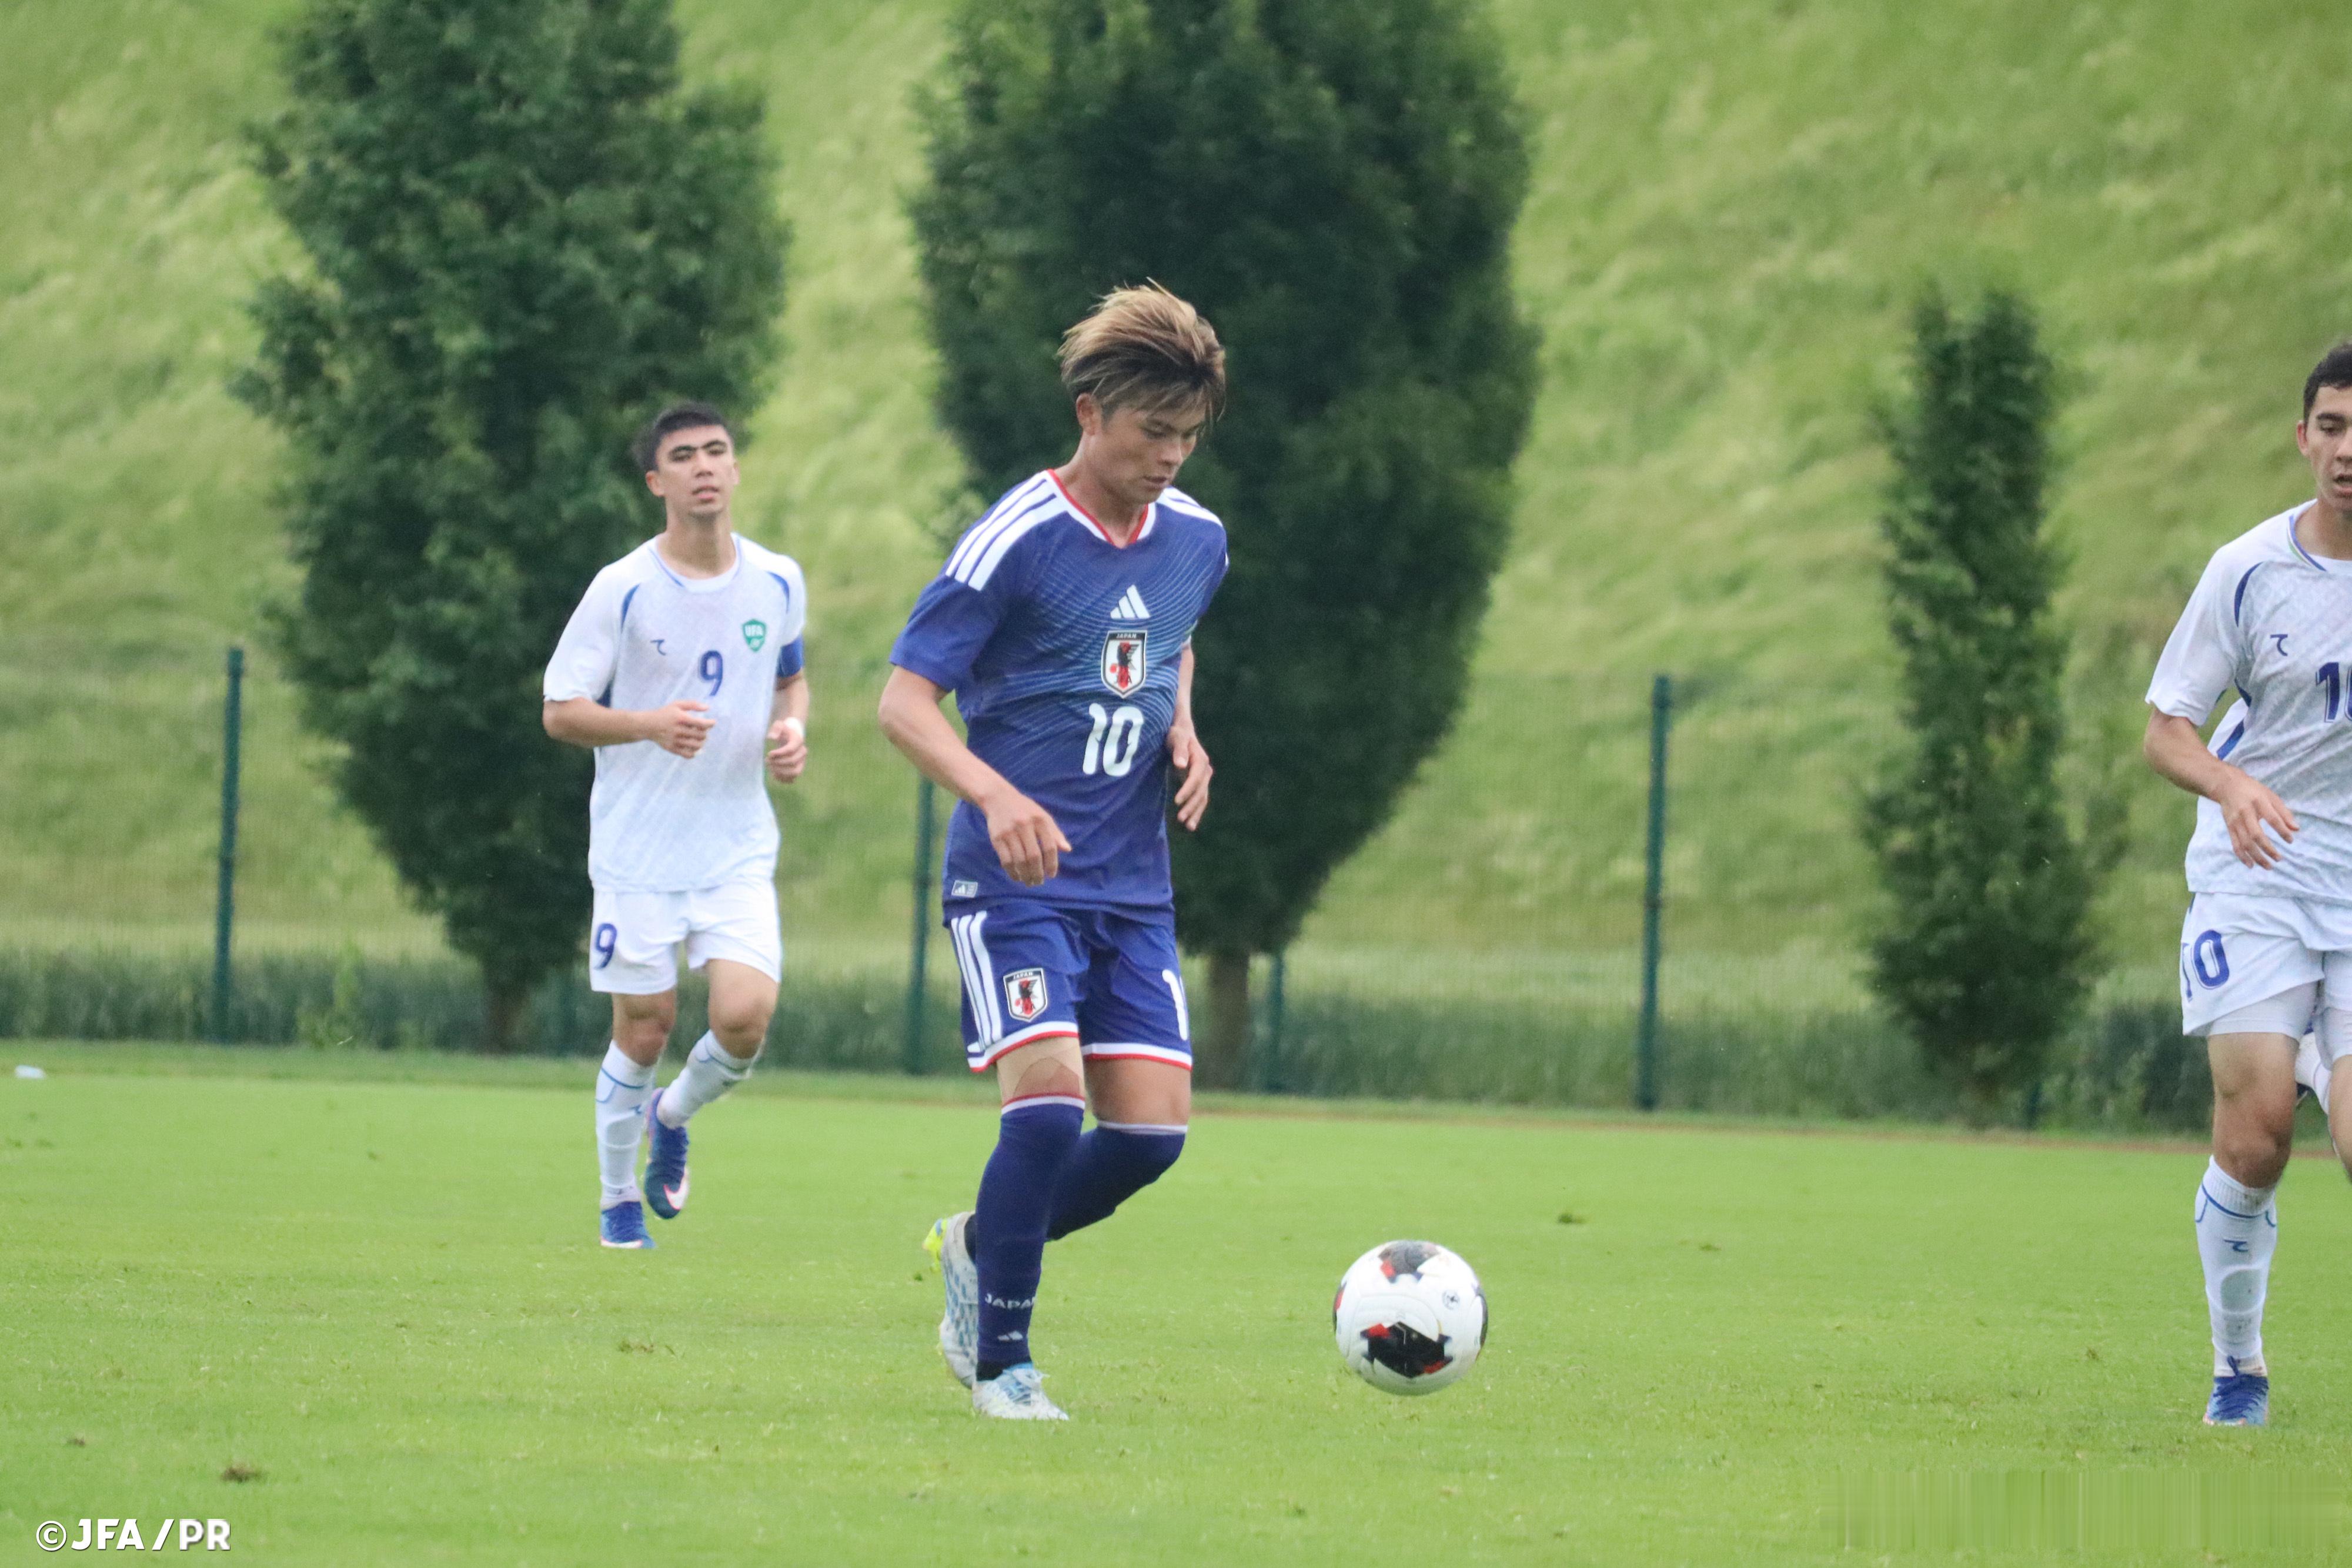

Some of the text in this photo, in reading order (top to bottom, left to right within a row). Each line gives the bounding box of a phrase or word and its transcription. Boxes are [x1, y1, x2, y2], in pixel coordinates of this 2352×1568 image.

[744, 624, 763, 636] UFA
[700, 650, 723, 697] 9
[2316, 661, 2352, 723] 1
[1083, 703, 1144, 777] 10
[594, 922, 617, 970] 9
[1162, 969, 1188, 1041] 1
